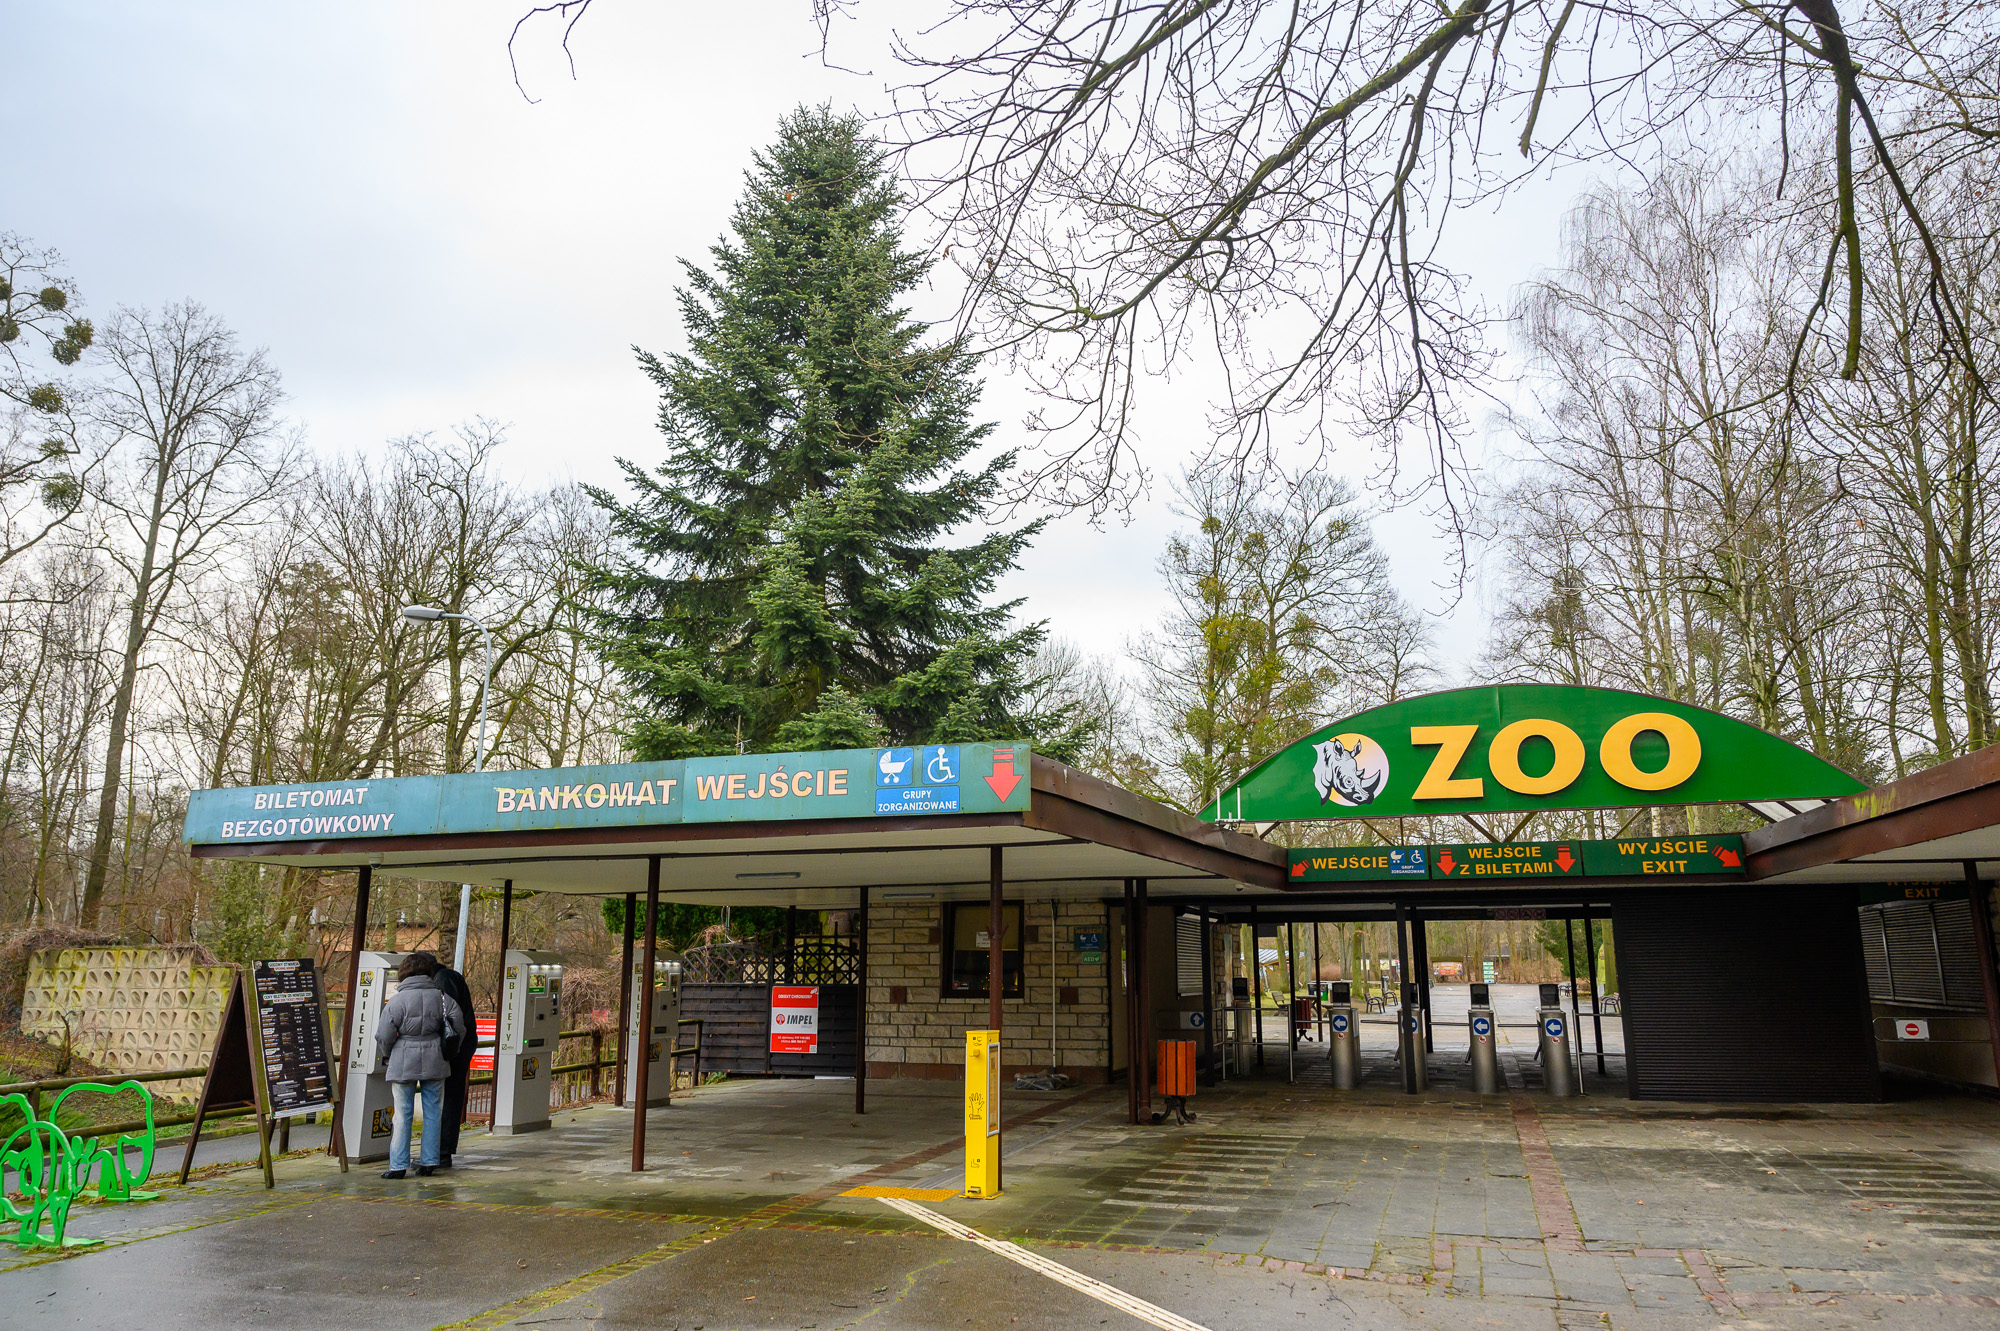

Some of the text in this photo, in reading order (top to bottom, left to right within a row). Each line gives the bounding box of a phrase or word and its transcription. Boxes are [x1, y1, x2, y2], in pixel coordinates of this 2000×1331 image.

[1410, 712, 1702, 801] ZOO
[695, 765, 850, 802] WEJŚCIE
[253, 787, 369, 811] BILETOMAT
[495, 778, 678, 814] BANKOMAT
[902, 790, 932, 800] GRUPY
[878, 800, 958, 812] ZORGANIZOWANE
[220, 813, 395, 839] BEZGOTÓWKOWY
[1467, 844, 1542, 859] WEJŚCIE
[1617, 838, 1709, 855] WYJŚCIE
[1311, 854, 1389, 870] WEJŚCIE
[1459, 862, 1553, 875] Z BILETAMI
[1642, 860, 1688, 874] EXIT
[1905, 888, 1940, 898] EXIT
[635, 976, 643, 1029] BILETY
[506, 982, 515, 1042] BILETY
[787, 1015, 812, 1024] IMPEL
[357, 989, 368, 1058] BILETY
